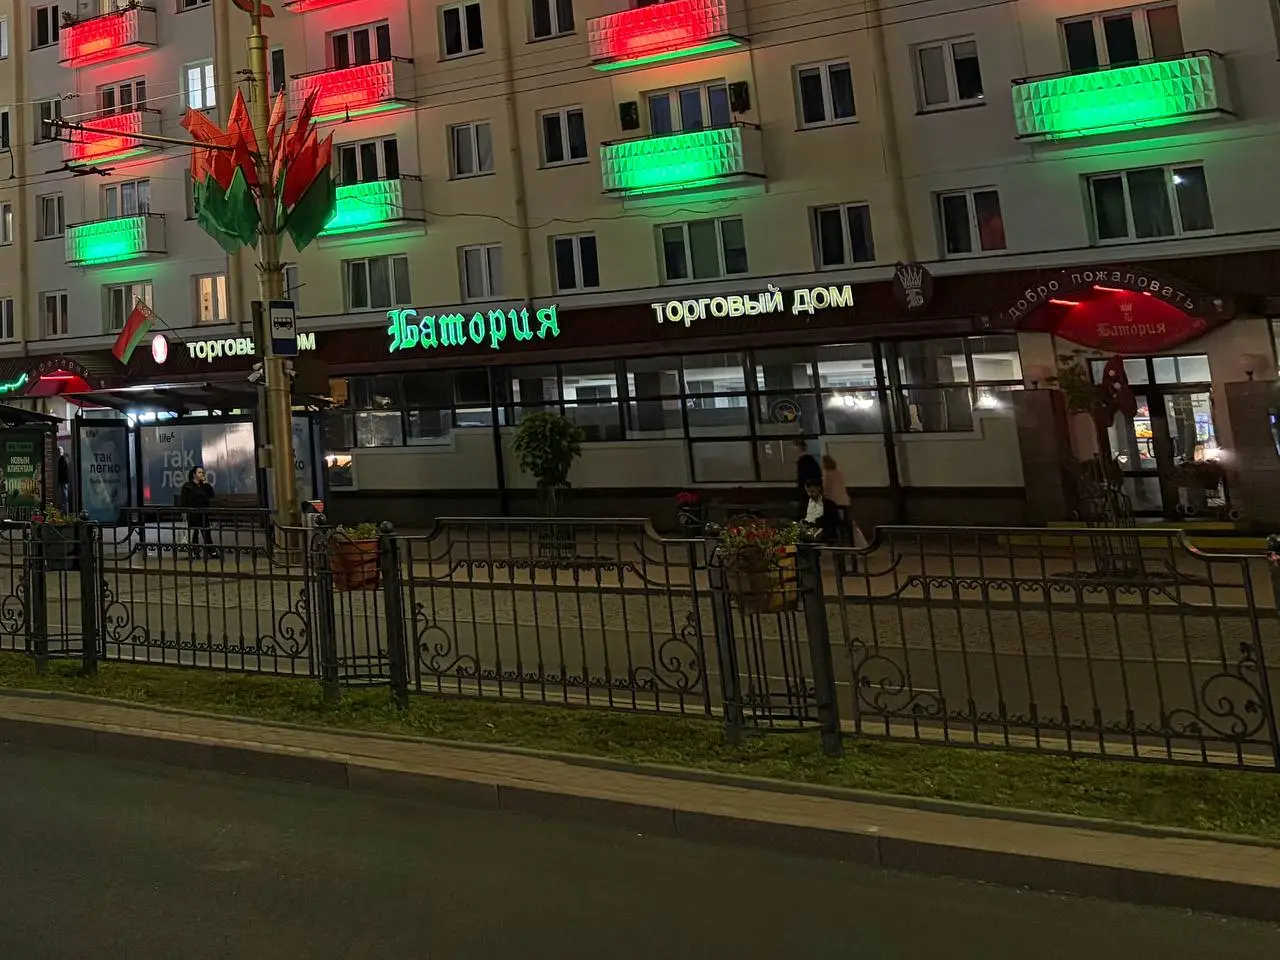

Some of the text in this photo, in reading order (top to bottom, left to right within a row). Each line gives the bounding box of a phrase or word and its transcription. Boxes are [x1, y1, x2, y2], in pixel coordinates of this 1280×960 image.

[1007, 270, 1195, 320] добро пожаловать
[651, 285, 784, 327] торговый
[387, 303, 561, 353] Батория
[1096, 322, 1167, 338] Батория
[94, 452, 112, 462] так
[163, 449, 195, 468] так
[90, 463, 120, 473] легко
